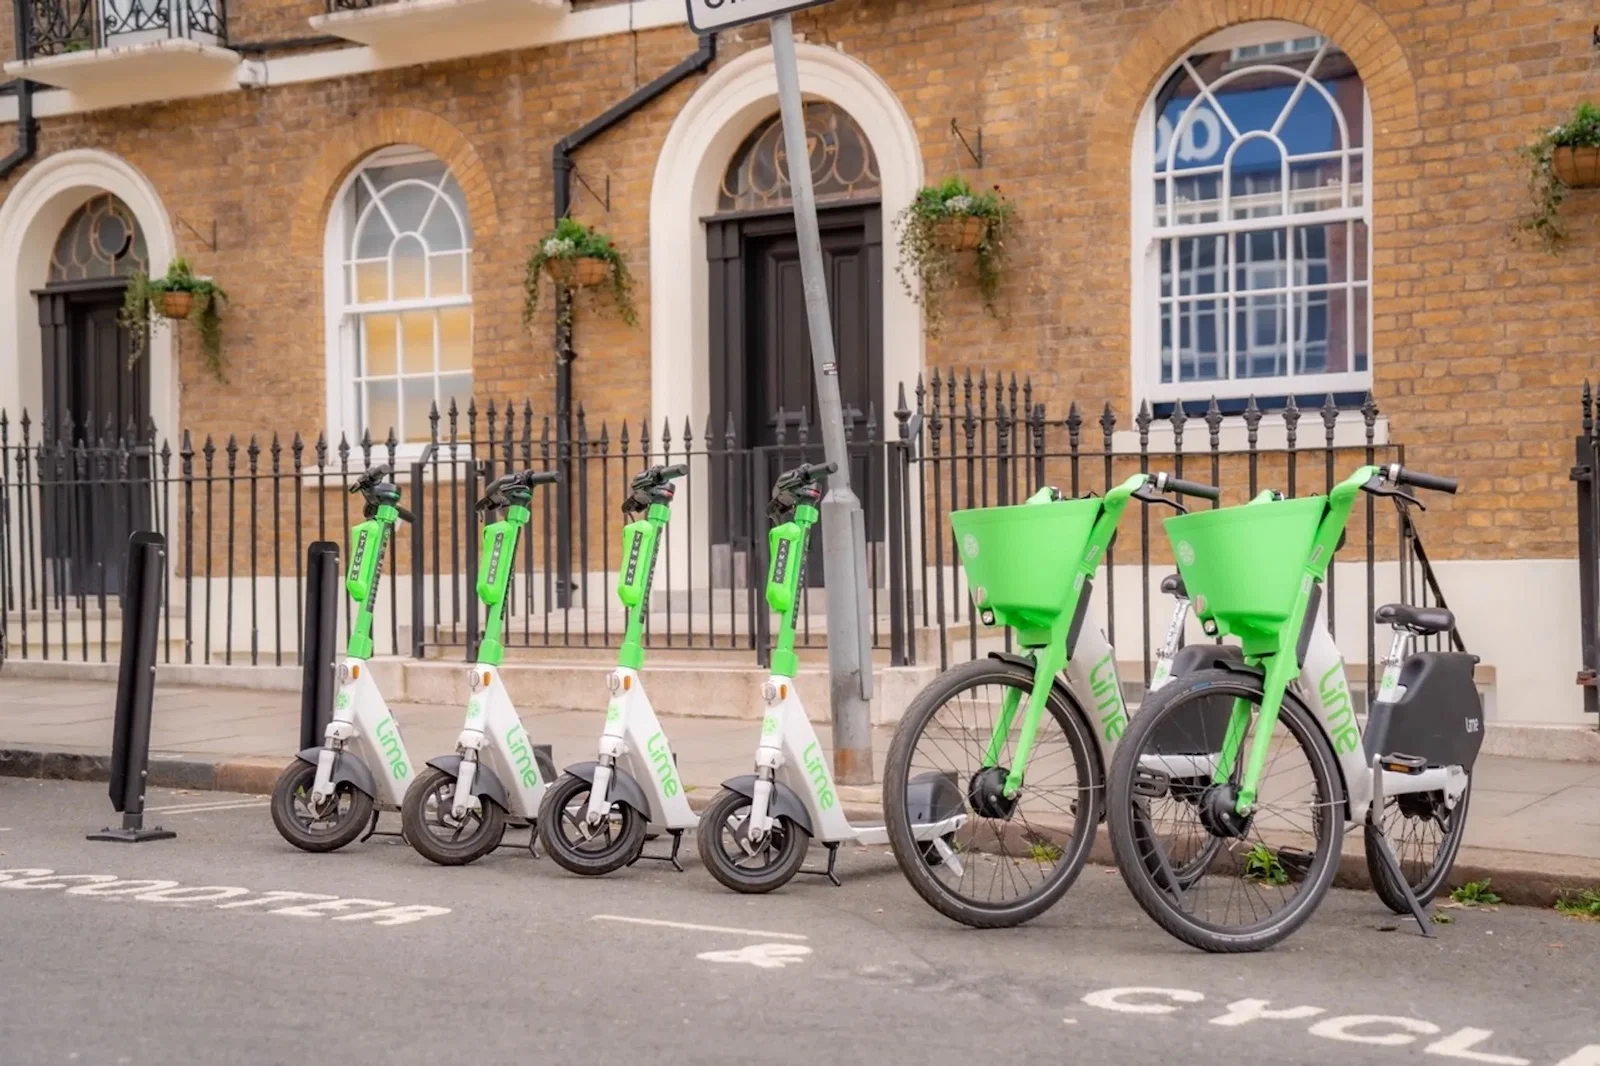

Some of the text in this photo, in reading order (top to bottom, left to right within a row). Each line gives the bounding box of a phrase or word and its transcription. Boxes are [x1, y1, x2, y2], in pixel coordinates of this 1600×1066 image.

[1088, 655, 1126, 742] Lime
[1318, 662, 1359, 755] Lime
[375, 717, 408, 780] Lime
[506, 724, 537, 790] Lime
[647, 732, 678, 799] Lime
[803, 741, 834, 811] Lime
